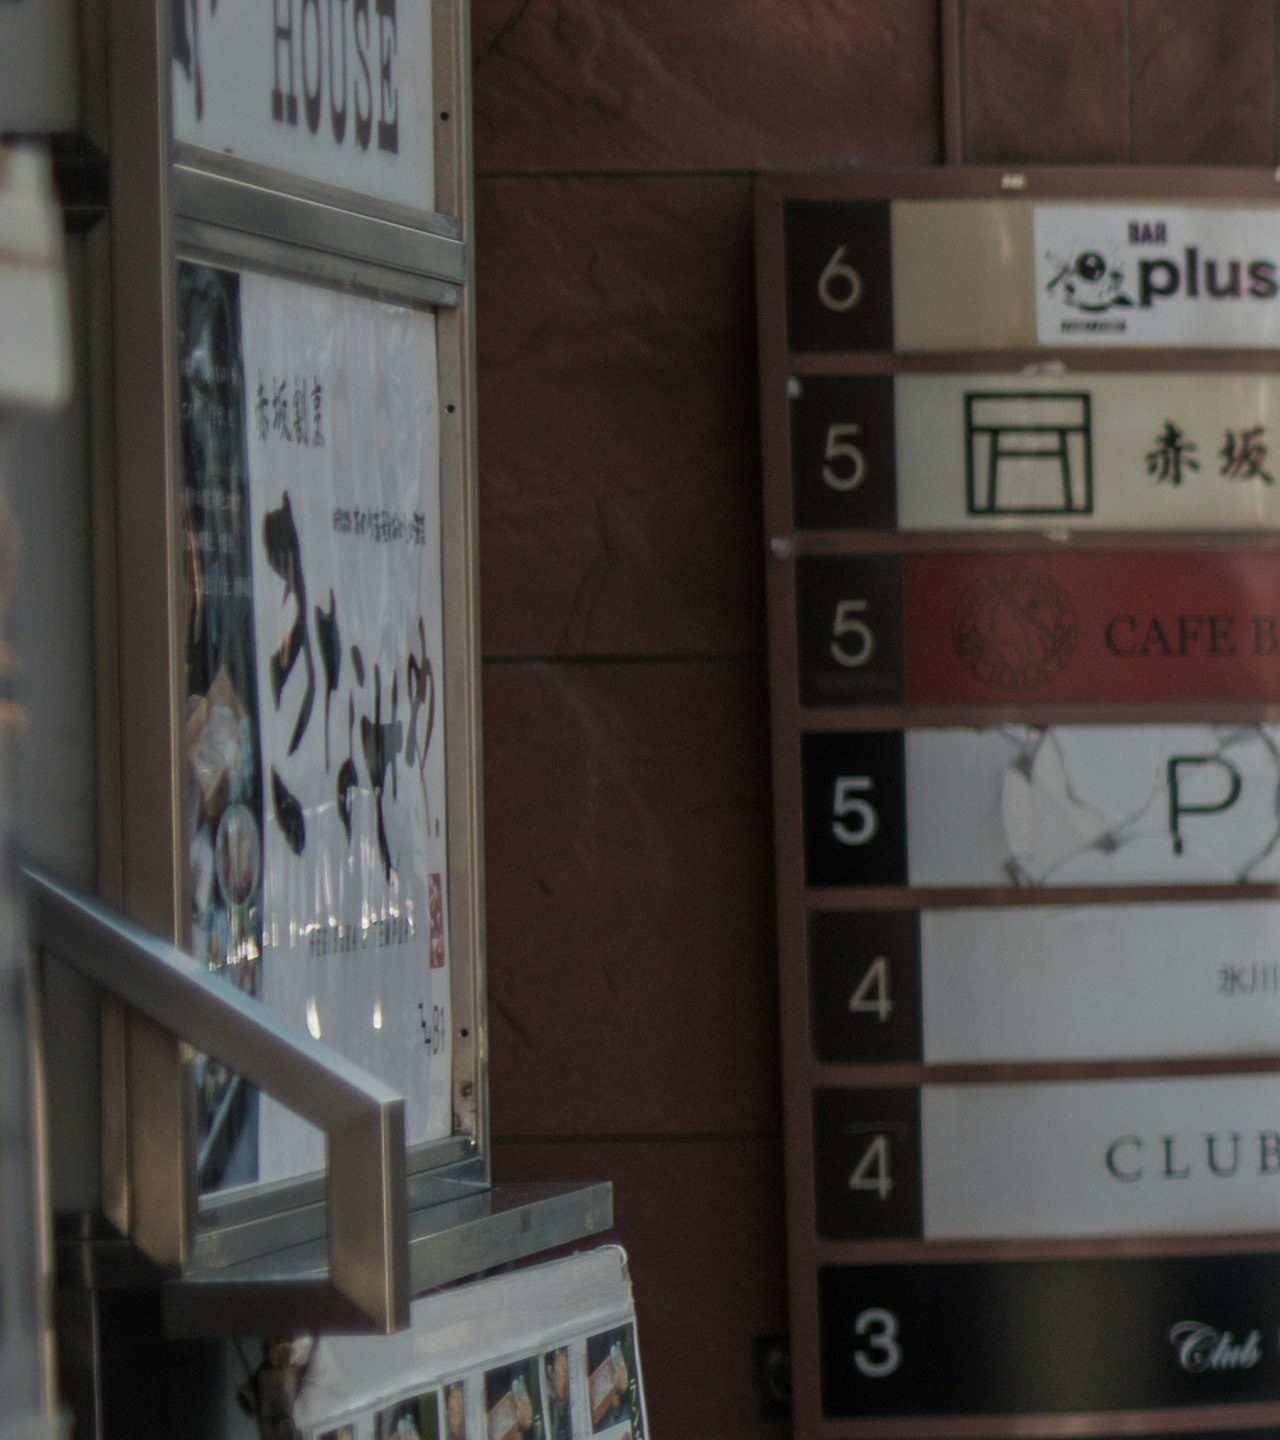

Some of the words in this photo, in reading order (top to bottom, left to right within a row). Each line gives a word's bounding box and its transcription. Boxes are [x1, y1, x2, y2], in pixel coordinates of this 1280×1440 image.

[271, 0, 399, 154] HOUSE
[1129, 220, 1167, 245] BAR
[817, 246, 863, 312] 6
[822, 423, 867, 492] 5
[1145, 418, 1276, 487] 赤坂
[829, 599, 876, 668] 5
[1104, 613, 1238, 658] CAFE
[831, 775, 878, 847] 5
[848, 955, 894, 1024] 4
[848, 1132, 894, 1202] 4
[853, 1307, 903, 1379] 3
[1169, 1319, 1263, 1374] Club
